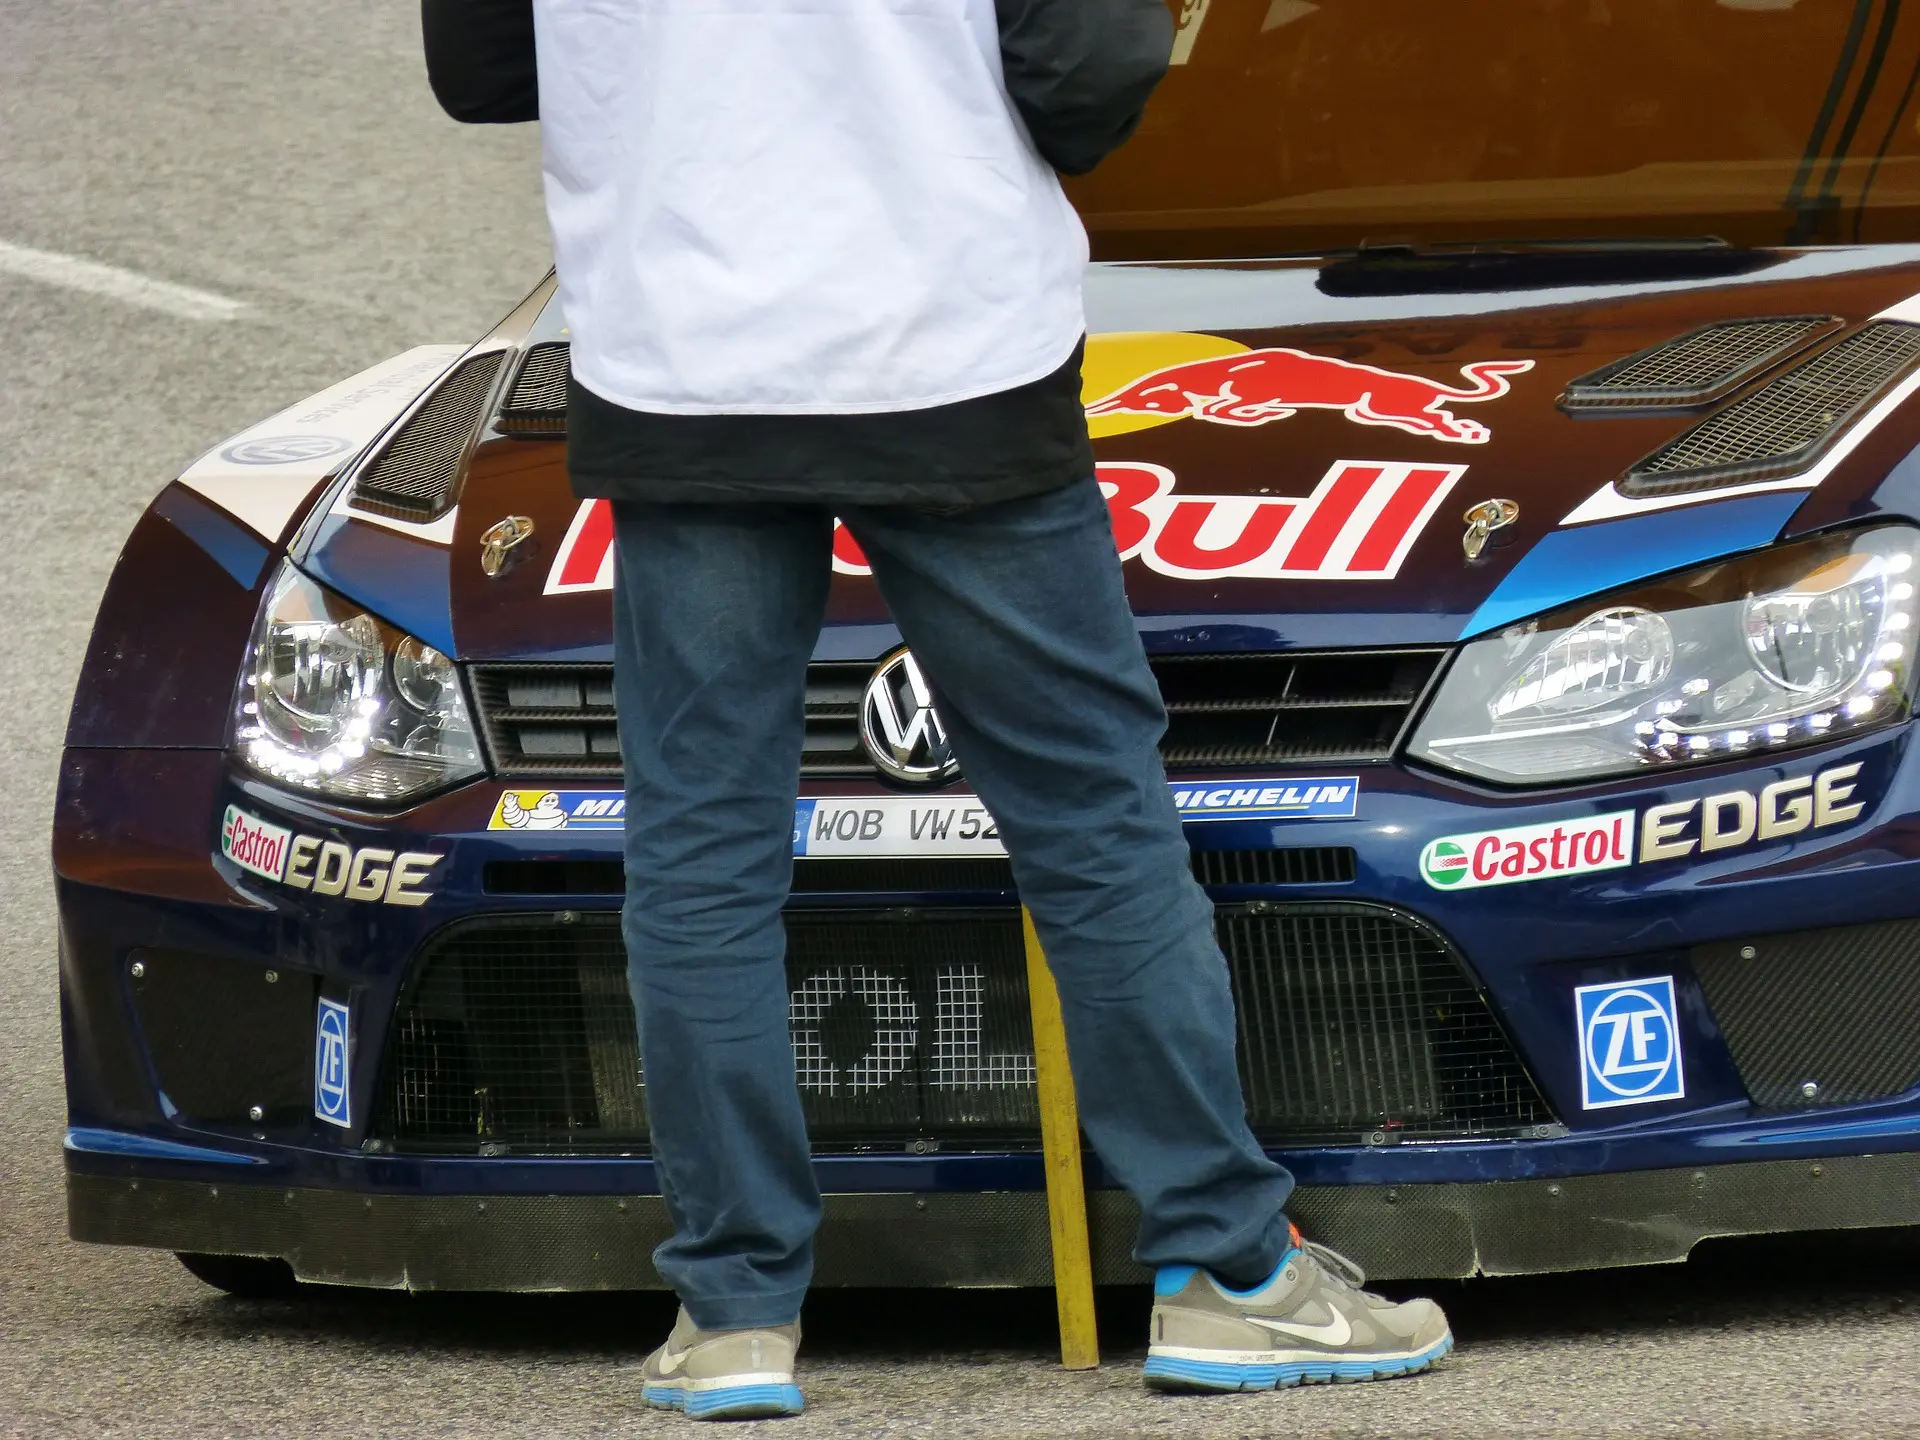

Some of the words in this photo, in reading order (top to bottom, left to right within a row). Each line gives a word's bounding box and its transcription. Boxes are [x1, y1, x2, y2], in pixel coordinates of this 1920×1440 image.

[815, 809, 884, 841] WOB
[910, 808, 955, 841] VW
[1174, 786, 1351, 807] ICHELIN
[1471, 817, 1626, 882] Castrol
[1639, 761, 1867, 863] EDGE
[230, 805, 286, 876] Castrol
[284, 834, 444, 906] EDGE
[319, 1031, 345, 1093] ZF
[788, 964, 1036, 1098] OL
[1593, 1008, 1669, 1077] ZF
